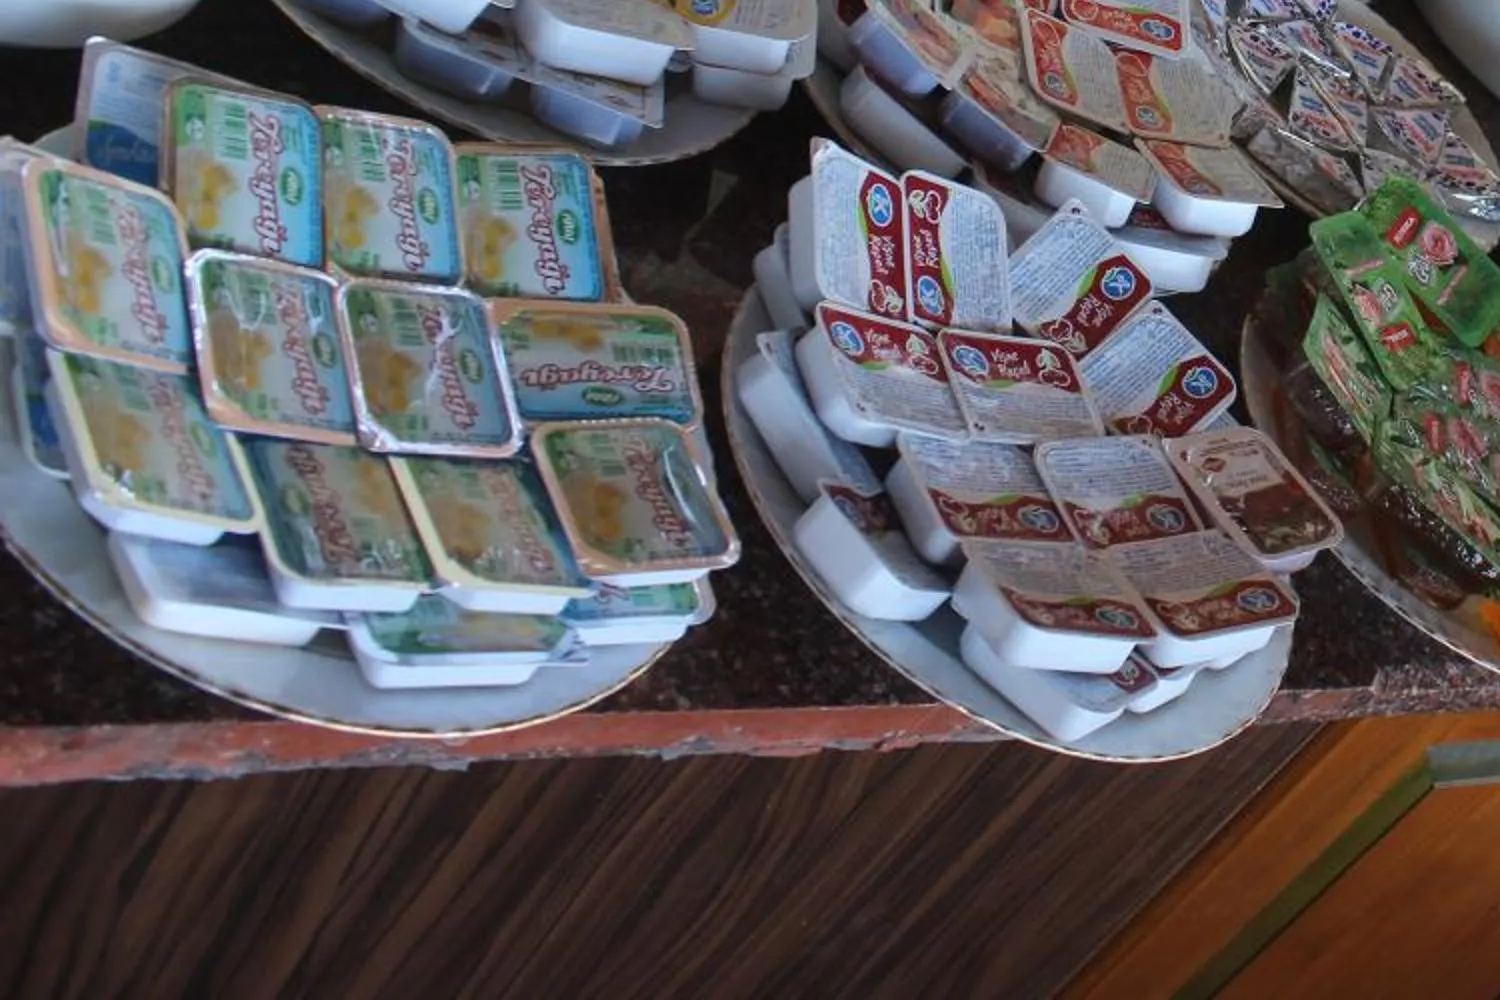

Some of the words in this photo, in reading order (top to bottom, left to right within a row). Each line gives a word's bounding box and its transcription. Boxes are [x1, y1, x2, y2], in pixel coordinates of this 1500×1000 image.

[249, 111, 287, 256] Tereyağı
[385, 139, 428, 272] Tereyağı
[522, 164, 570, 295] Tereyağı
[111, 201, 168, 343] Tereyağı
[520, 360, 674, 392] Tereyağı
